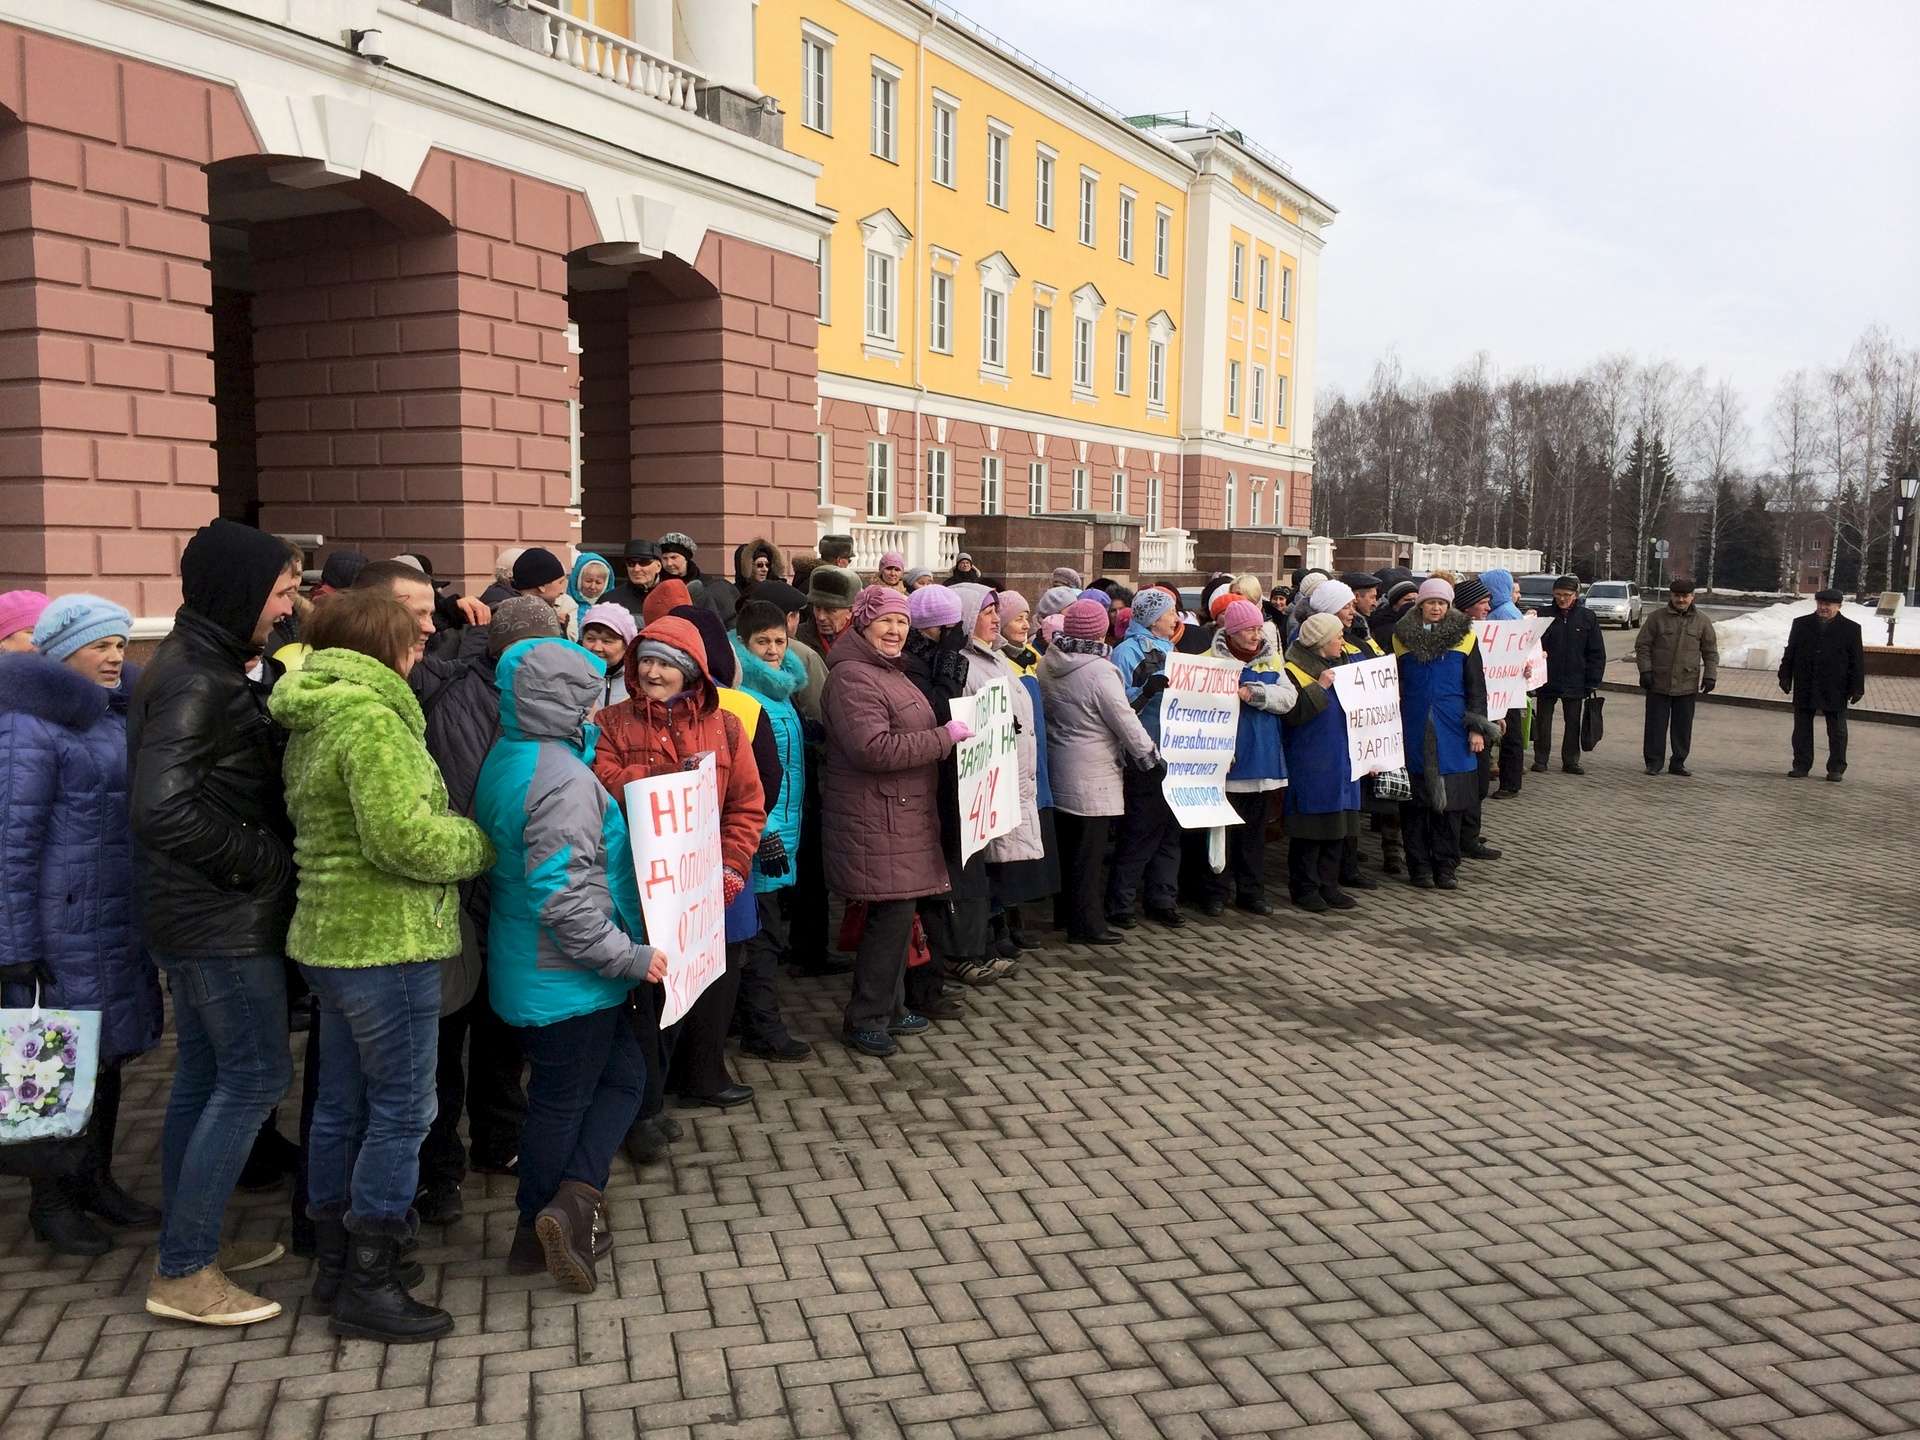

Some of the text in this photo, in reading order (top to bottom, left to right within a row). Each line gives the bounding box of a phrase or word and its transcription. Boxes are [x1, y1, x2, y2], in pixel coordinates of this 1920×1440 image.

[1482, 624, 1499, 653] 4
[1354, 666, 1365, 691] 4
[1166, 698, 1231, 723] Вступайте
[1350, 708, 1363, 729] НЕ
[1001, 721, 1017, 755] НА
